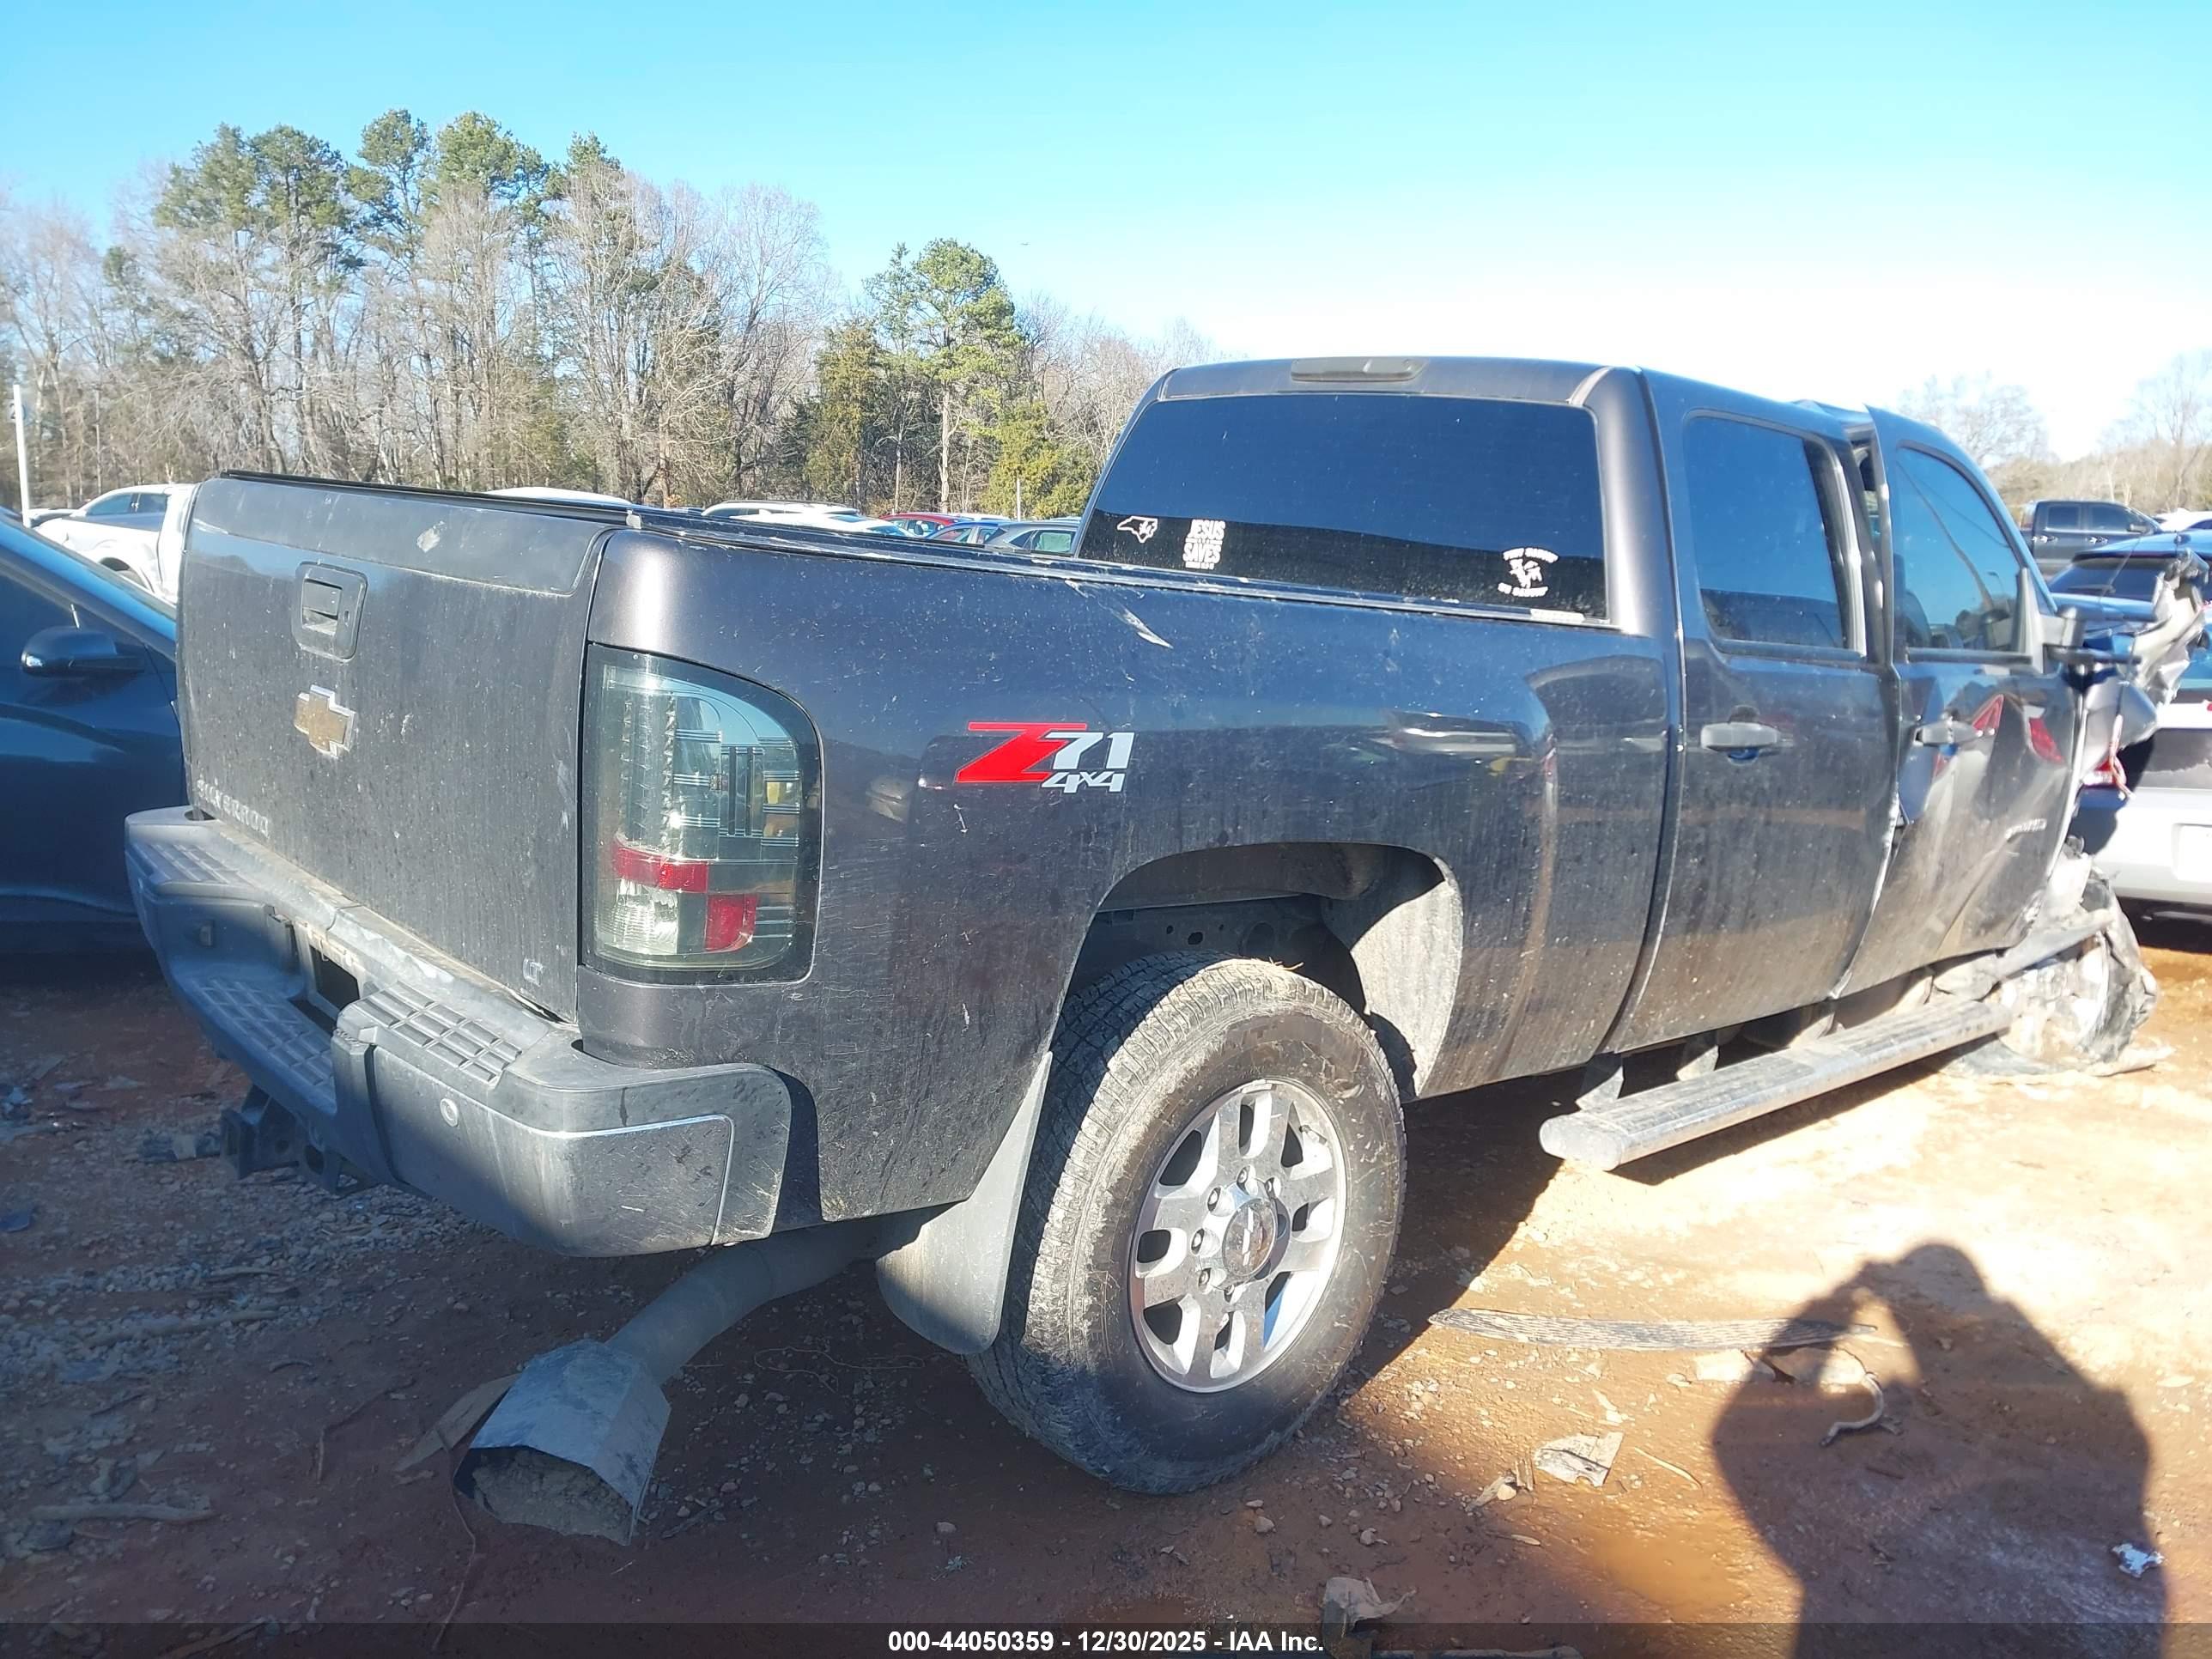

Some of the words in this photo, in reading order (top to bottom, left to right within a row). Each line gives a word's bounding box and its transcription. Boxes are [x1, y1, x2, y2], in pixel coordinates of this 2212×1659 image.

[1188, 520, 1226, 540] JESUS
[1182, 542, 1221, 563] SAVES
[955, 722, 1134, 783] Z71
[197, 779, 270, 839] SILVERADO
